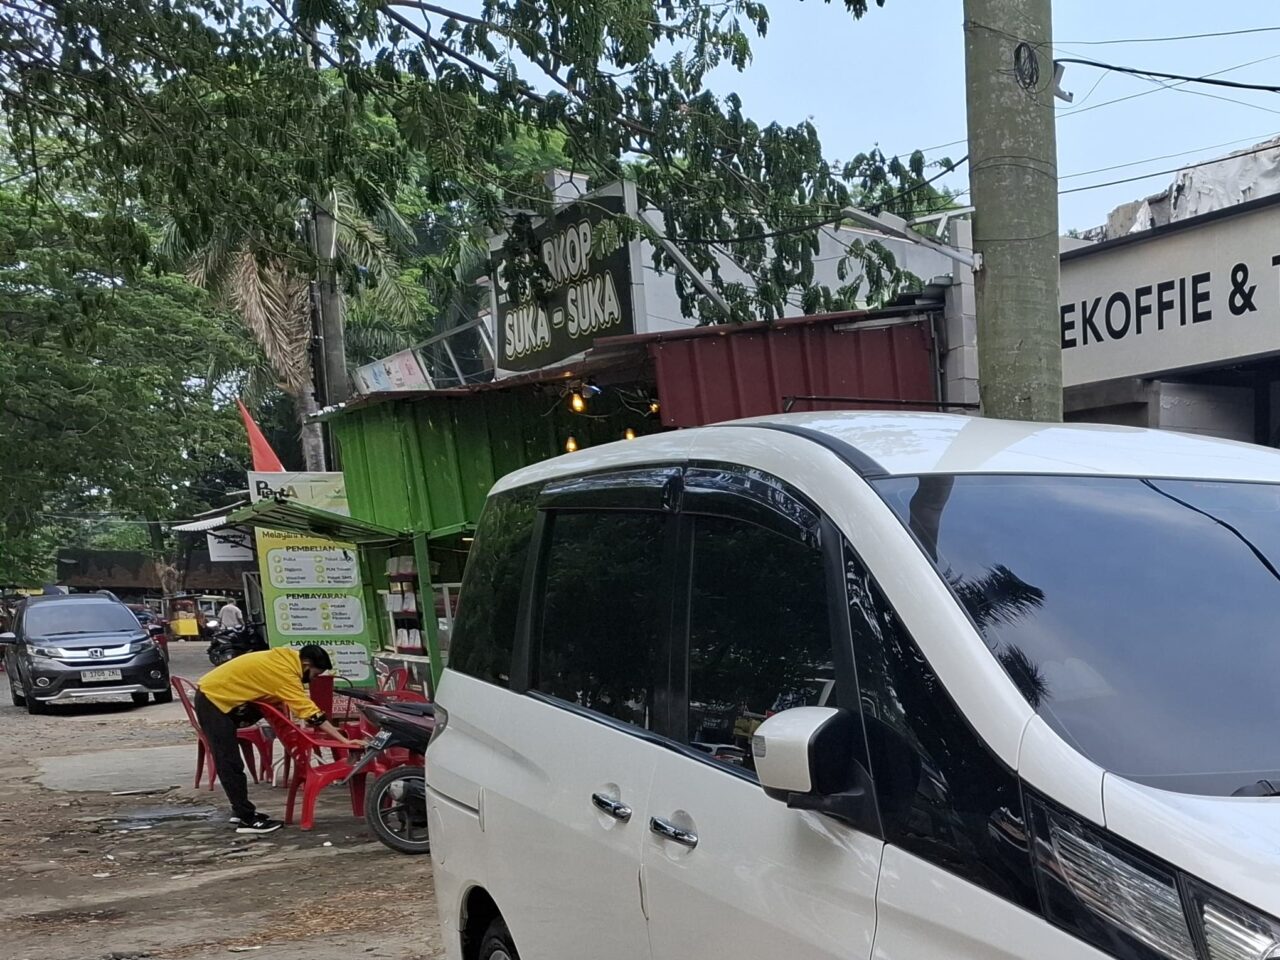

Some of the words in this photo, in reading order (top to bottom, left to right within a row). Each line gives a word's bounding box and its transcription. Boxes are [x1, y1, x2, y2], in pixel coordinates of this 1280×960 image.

[505, 302, 551, 360] SUKA
[567, 269, 622, 339] SUKA
[1228, 262, 1258, 316] &
[286, 592, 347, 600] PEMBAYARAN
